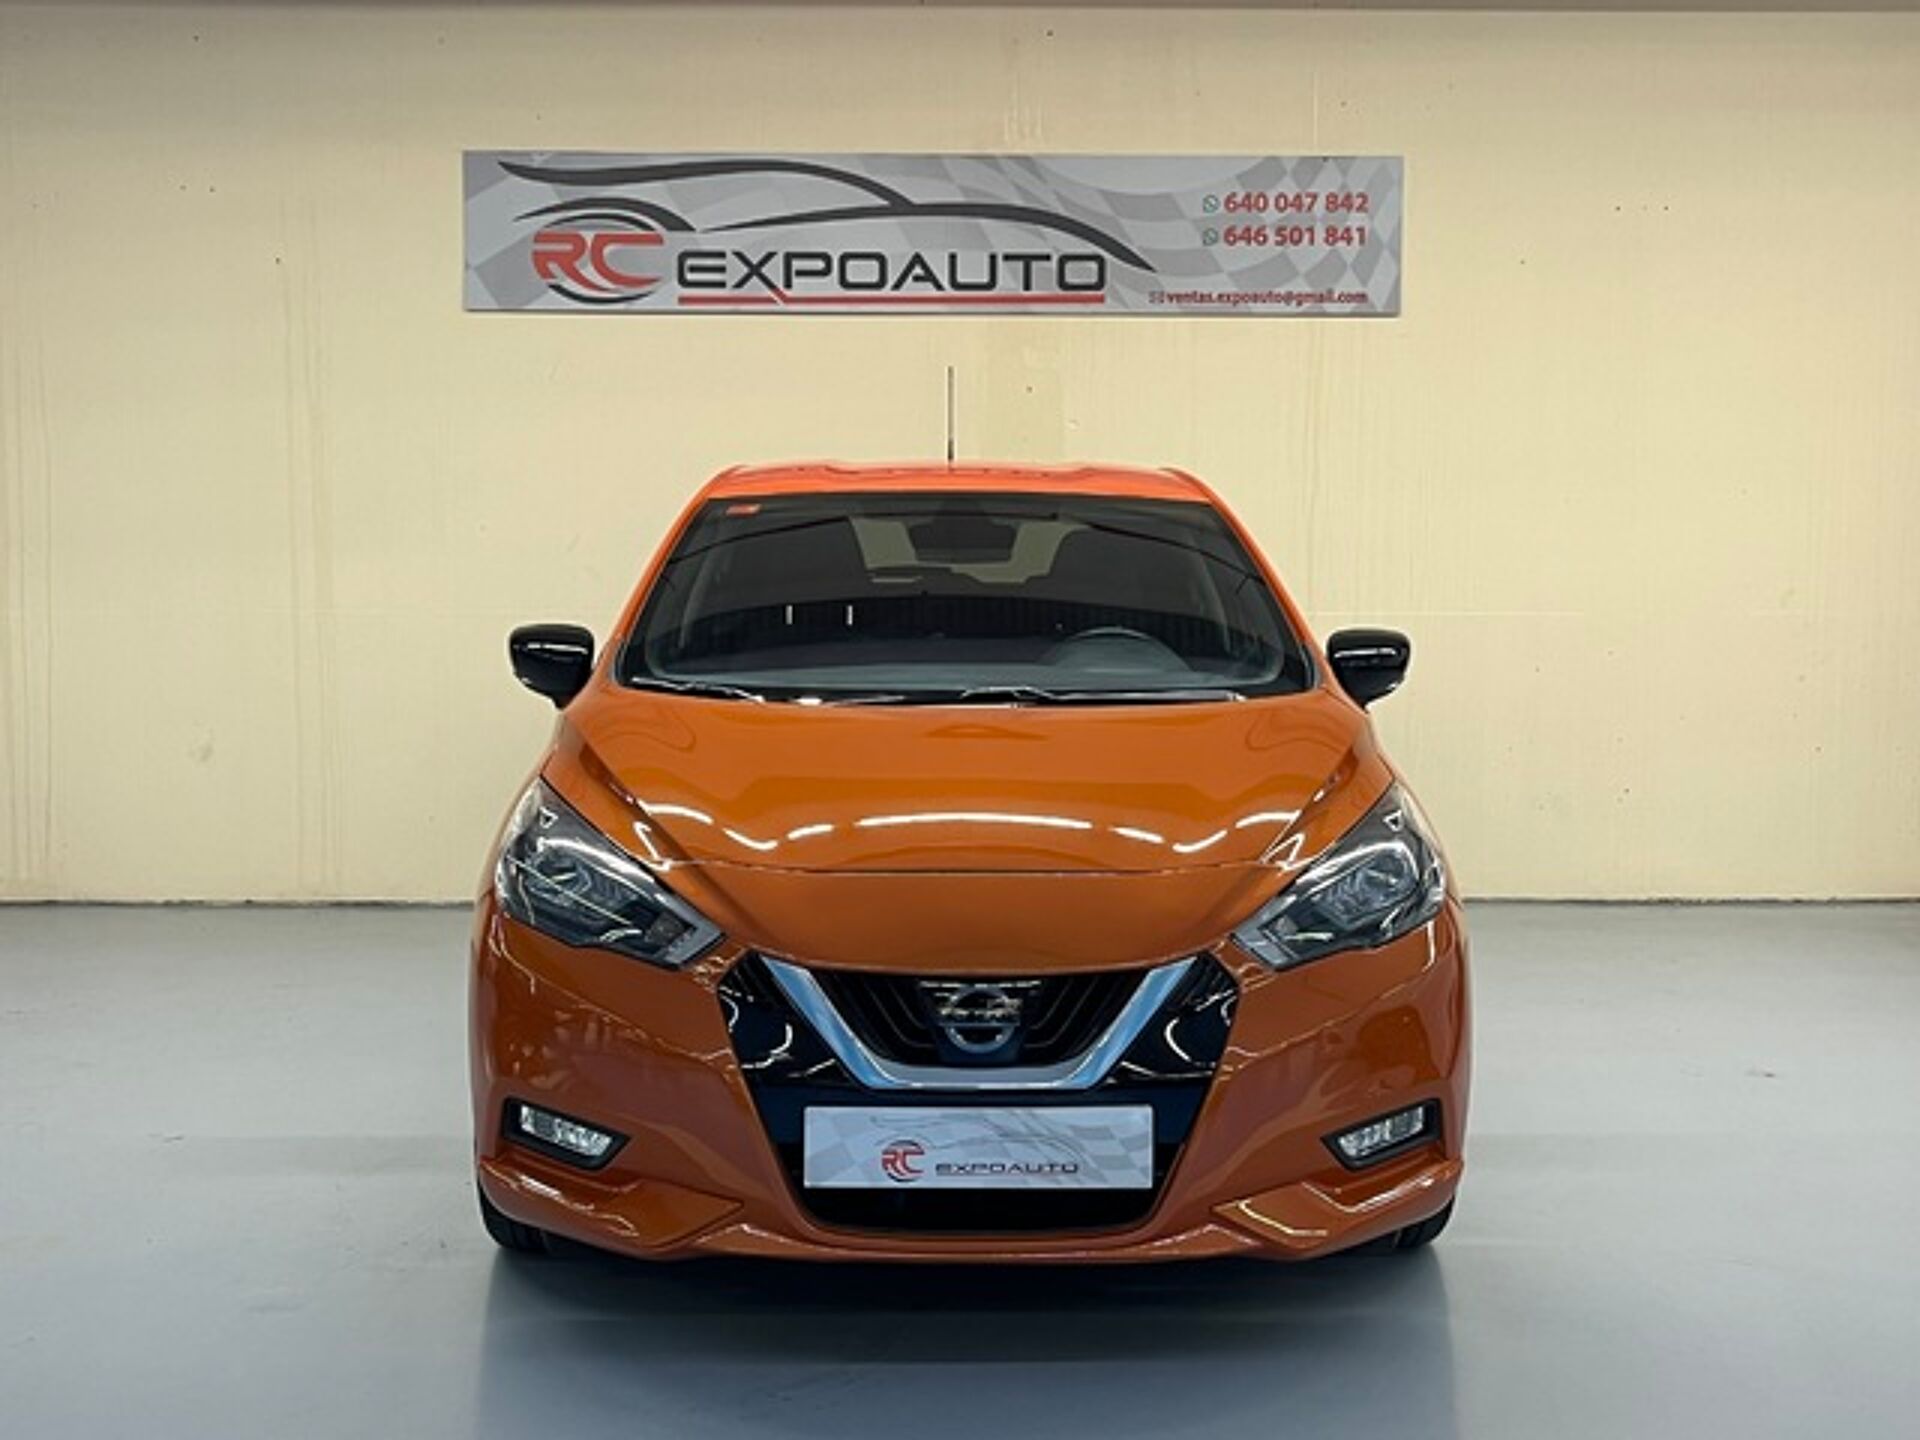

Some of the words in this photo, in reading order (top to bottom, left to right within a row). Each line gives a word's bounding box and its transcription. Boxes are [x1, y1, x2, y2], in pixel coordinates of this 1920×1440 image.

[1223, 191, 1269, 214] 640
[1274, 191, 1318, 214] 047
[1324, 191, 1369, 214] 842
[1223, 224, 1268, 247] 646
[1274, 224, 1316, 247] 501
[1324, 224, 1367, 247] 841
[531, 231, 665, 292] RC
[677, 251, 1106, 292] EXPOAUTO
[1167, 289, 1369, 306] ventas.expoauto@gmail.com
[881, 1149, 924, 1177] RC
[935, 1163, 1078, 1174] EXPOAUTO
